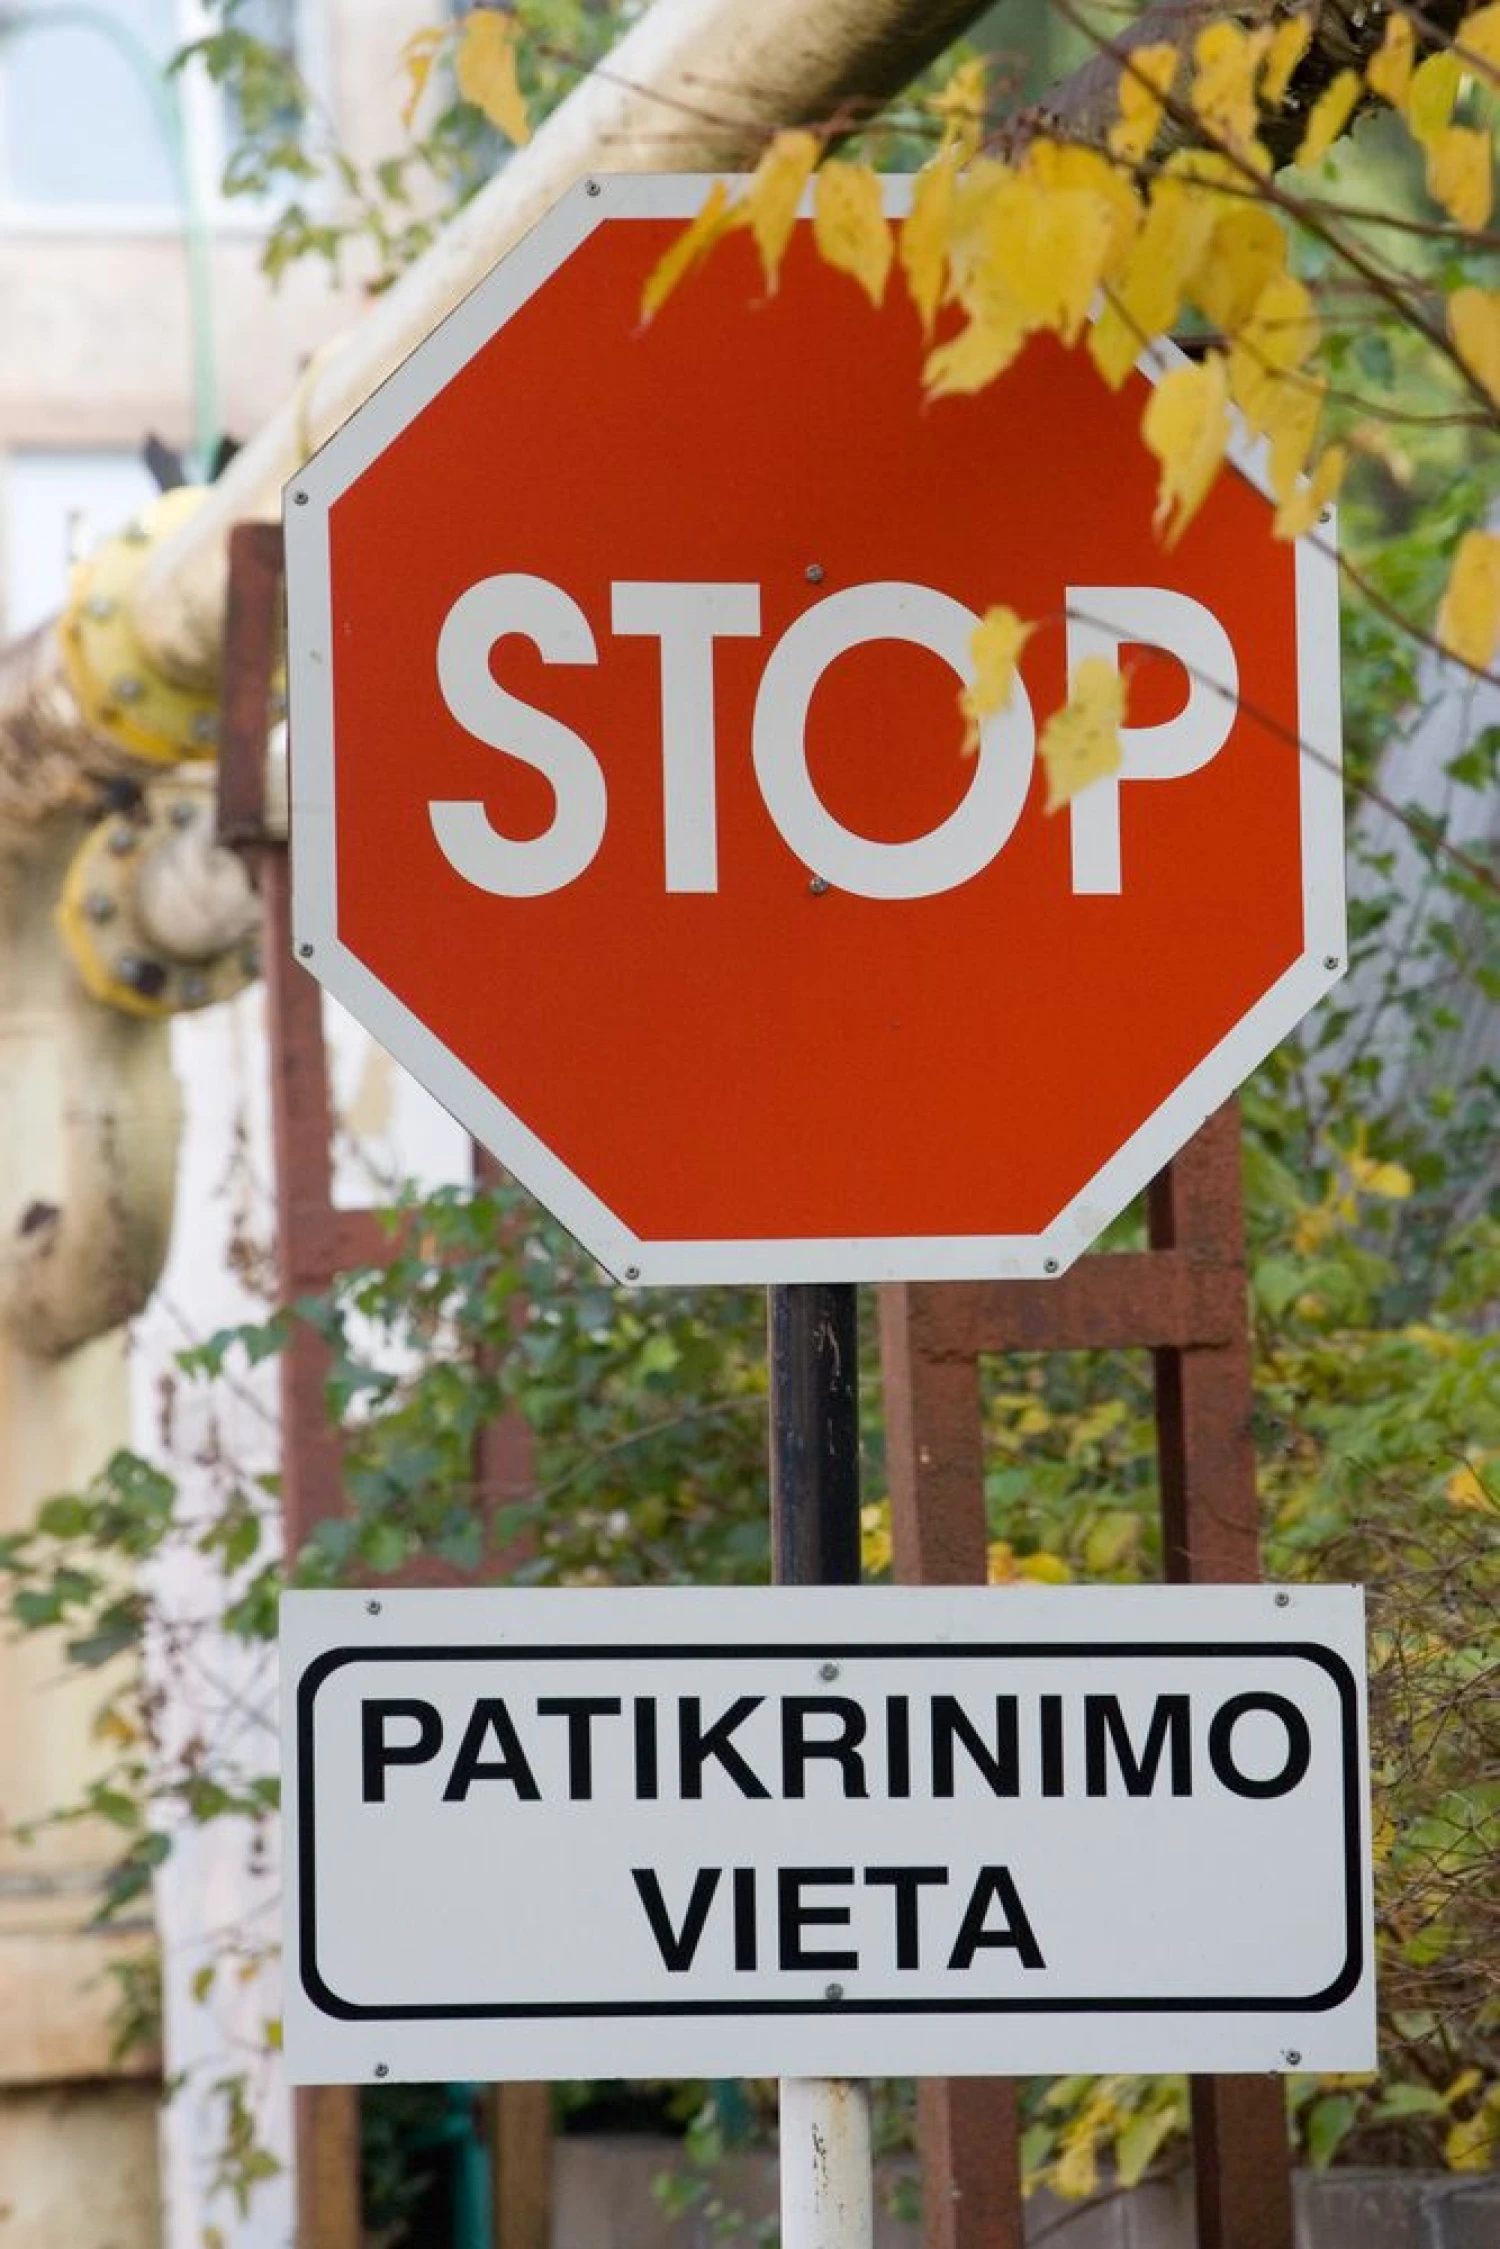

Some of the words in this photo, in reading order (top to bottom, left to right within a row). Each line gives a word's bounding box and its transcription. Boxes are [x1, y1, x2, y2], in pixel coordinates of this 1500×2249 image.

[429, 573, 1239, 899] STOP
[362, 1692, 1311, 1802] PATIKRINIMO
[632, 1867, 1046, 1972] VIETA
